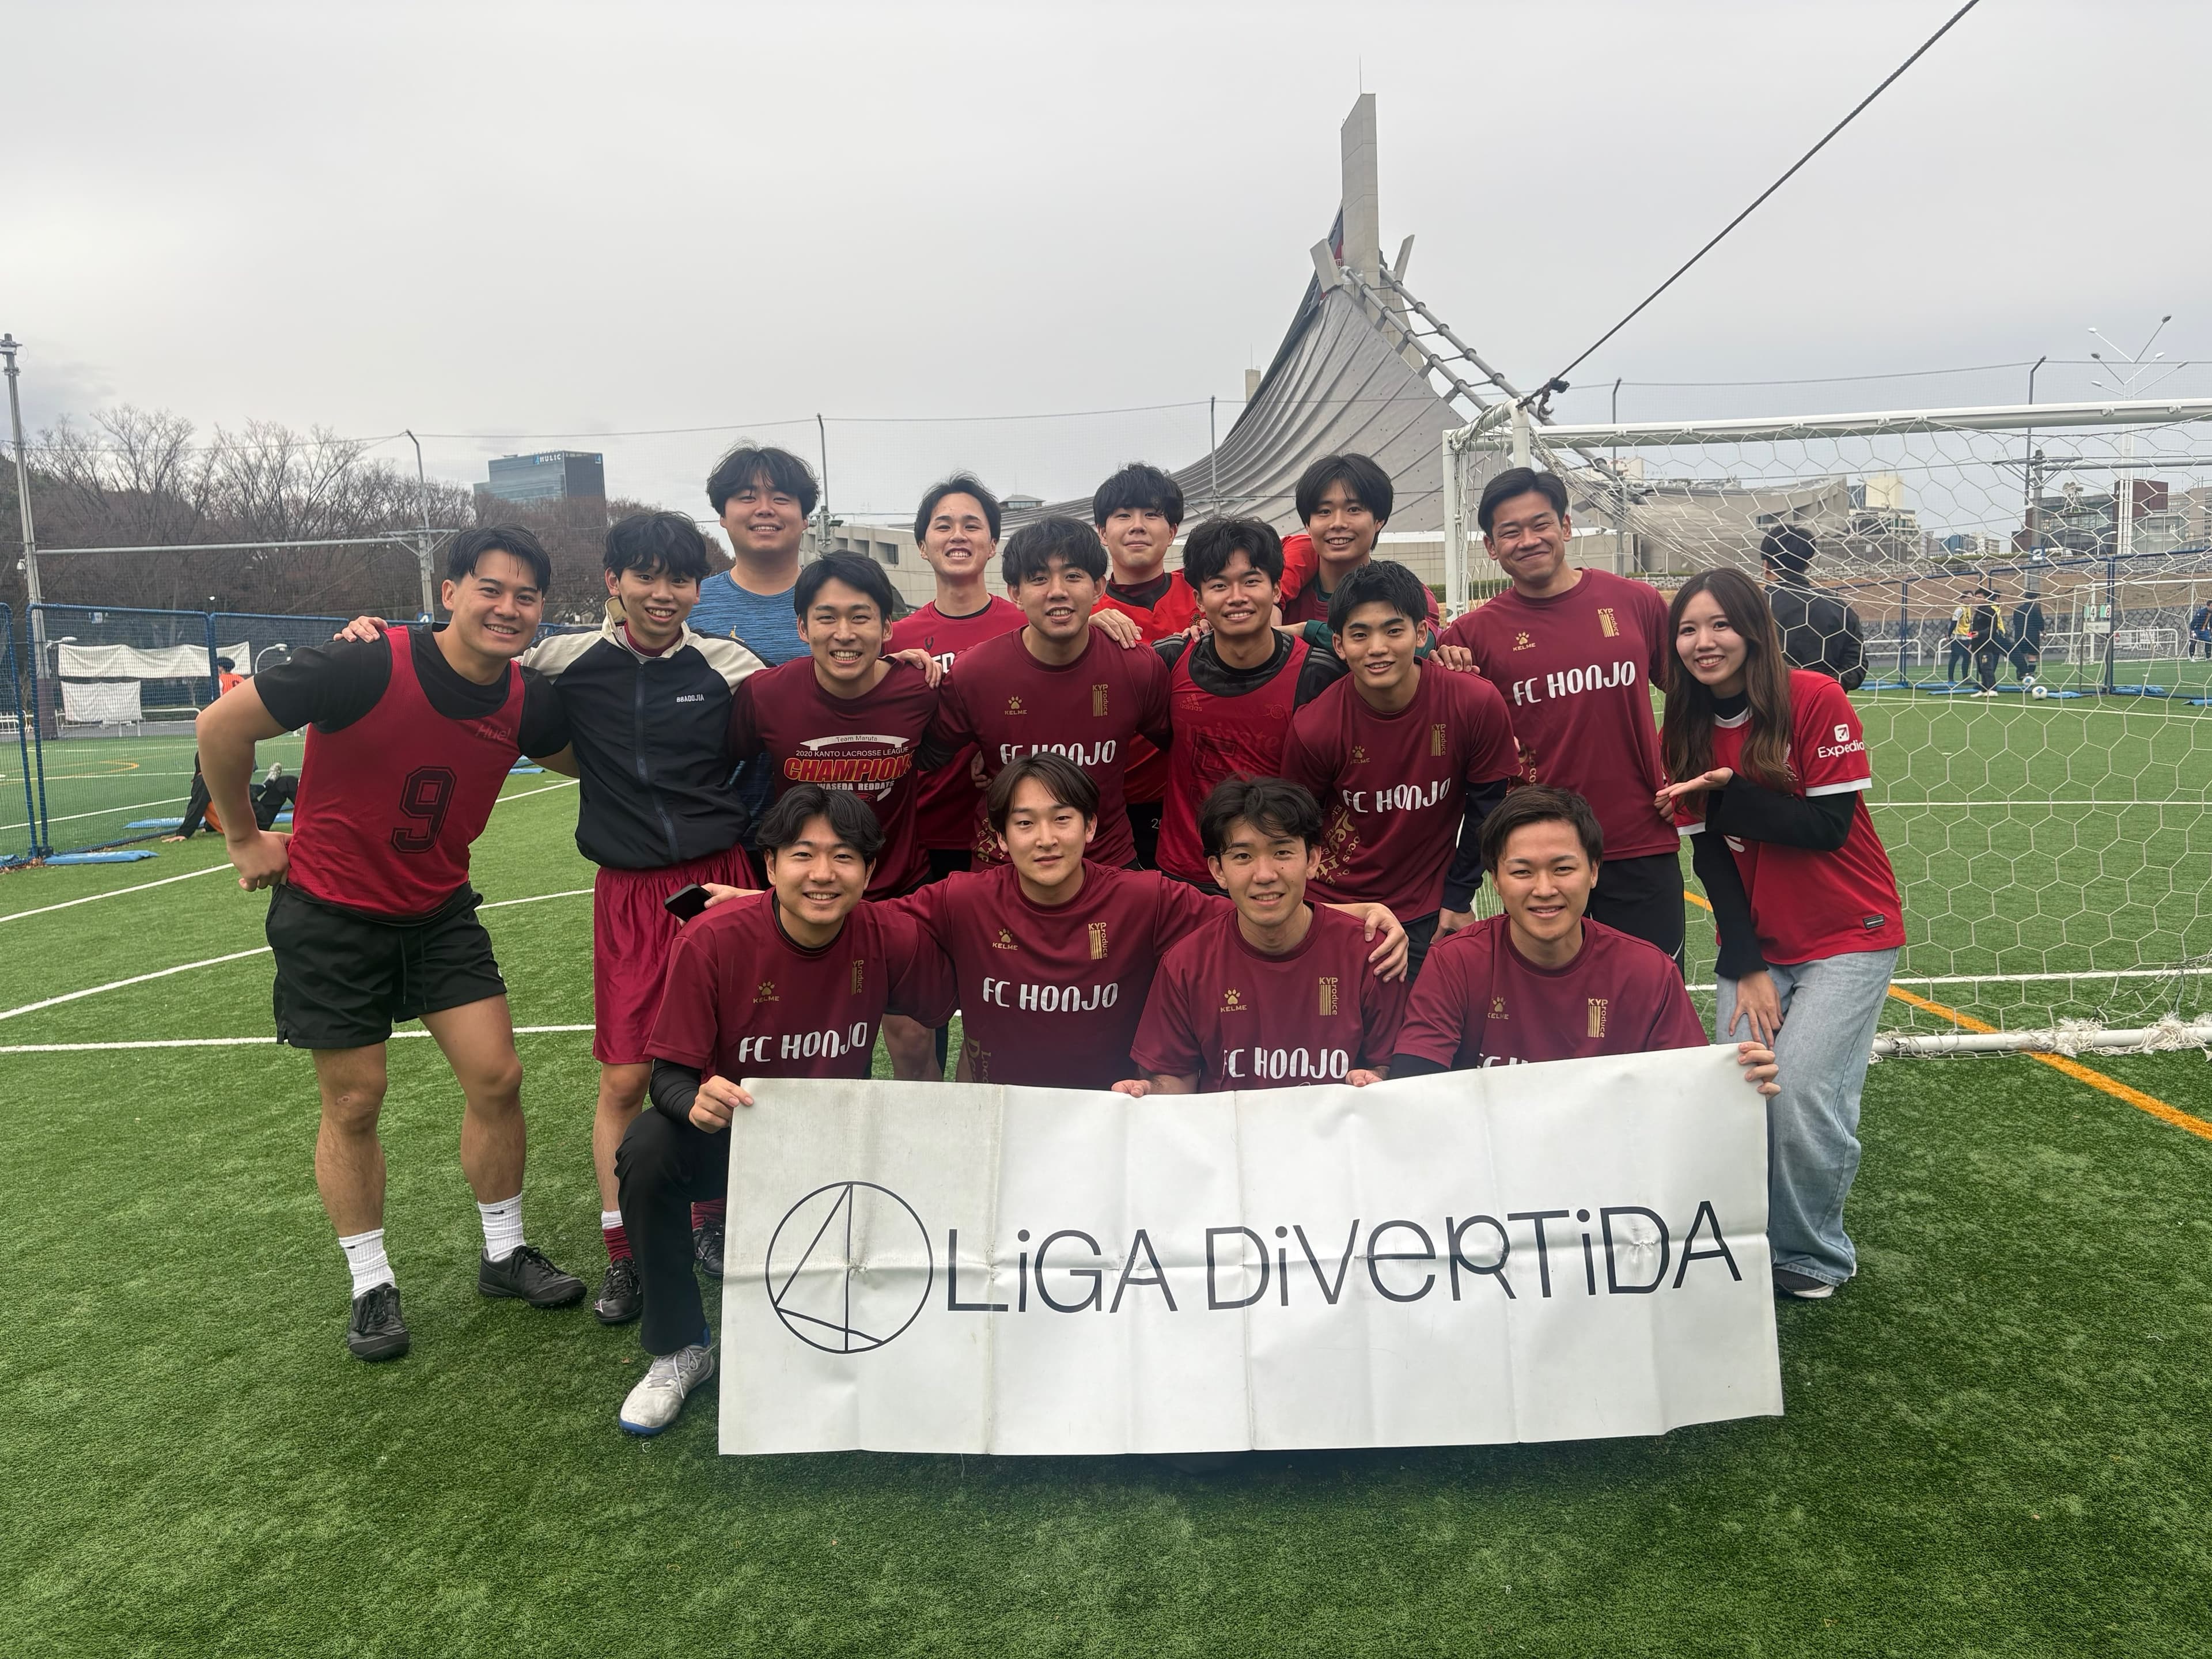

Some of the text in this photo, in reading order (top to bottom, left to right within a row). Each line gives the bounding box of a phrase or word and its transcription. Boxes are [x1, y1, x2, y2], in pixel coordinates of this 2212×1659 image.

[540, 453, 561, 463] HULIC
[1513, 642, 1536, 652] KELME
[1513, 677, 1542, 706] FC
[1180, 703, 1203, 712] adidas
[883, 747, 908, 756] LEAGUE
[1342, 789, 1369, 813] FC
[389, 765, 457, 854] 9
[992, 942, 1018, 950] KELME
[853, 959, 864, 967] YP
[983, 977, 1011, 1007] FC
[753, 995, 780, 1003] KELME
[1221, 1005, 1248, 1013] KELME
[738, 1036, 772, 1063] FC
